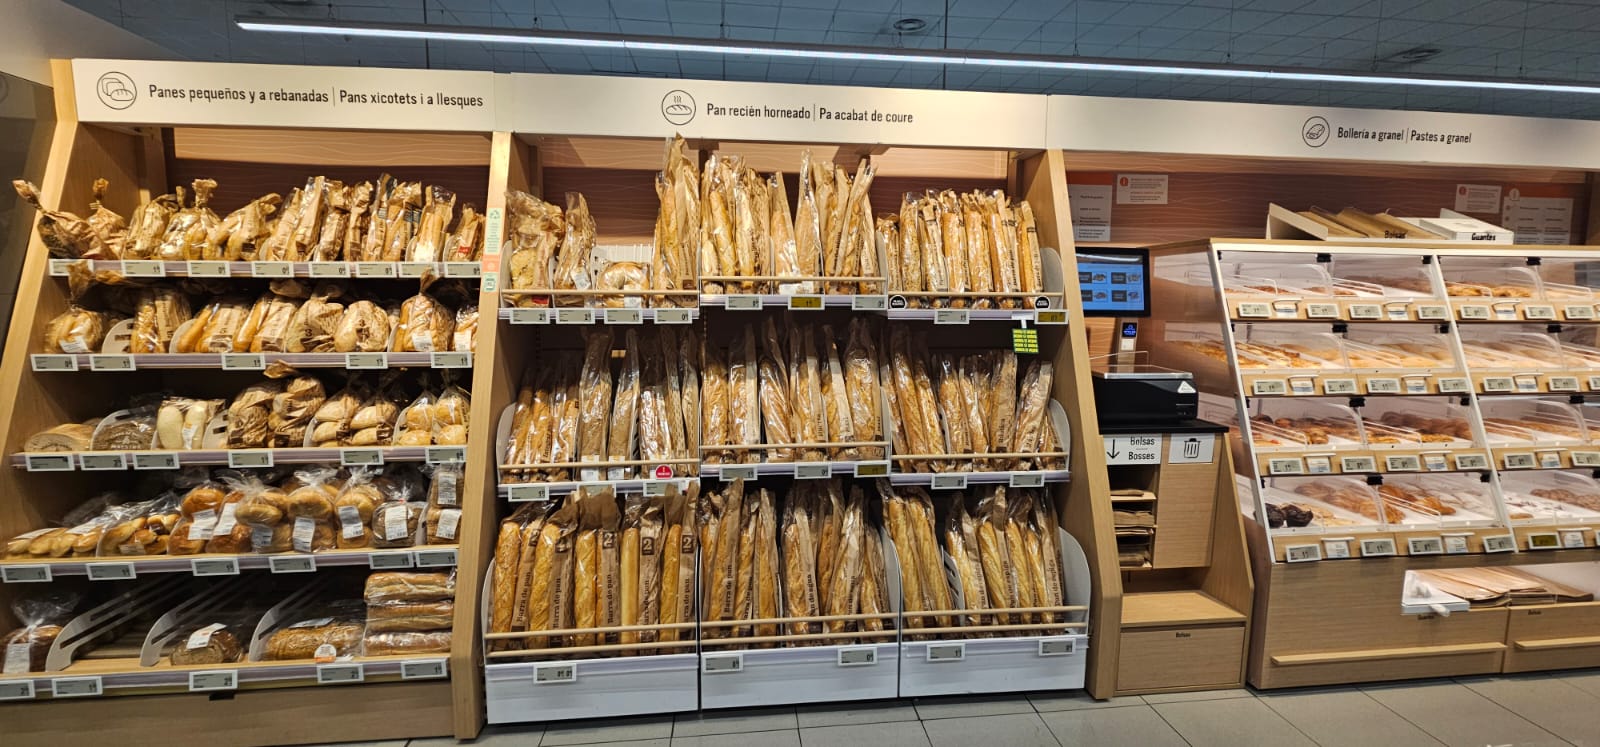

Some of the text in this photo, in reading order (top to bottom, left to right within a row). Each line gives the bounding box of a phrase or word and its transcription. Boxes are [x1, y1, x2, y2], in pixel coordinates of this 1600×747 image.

[148, 84, 484, 110] Panes pequeños y a rebanadas Pans xicotets i a llesques
[707, 103, 914, 124] Pan recién horneado Pa acabat de coure
[1337, 126, 1472, 145] Bollería a granel Pastes a granel
[1128, 451, 1155, 460] Bosses
[603, 532, 613, 546] 2
[643, 538, 652, 551] 2
[683, 536, 692, 549] 2
[1048, 559, 1057, 581] espiga
[516, 571, 533, 623] Barra de pan
[552, 577, 562, 629] Barra de pan
[606, 590, 612, 600] de
[1053, 592, 1061, 606] Pan
[606, 601, 614, 624] Barra
